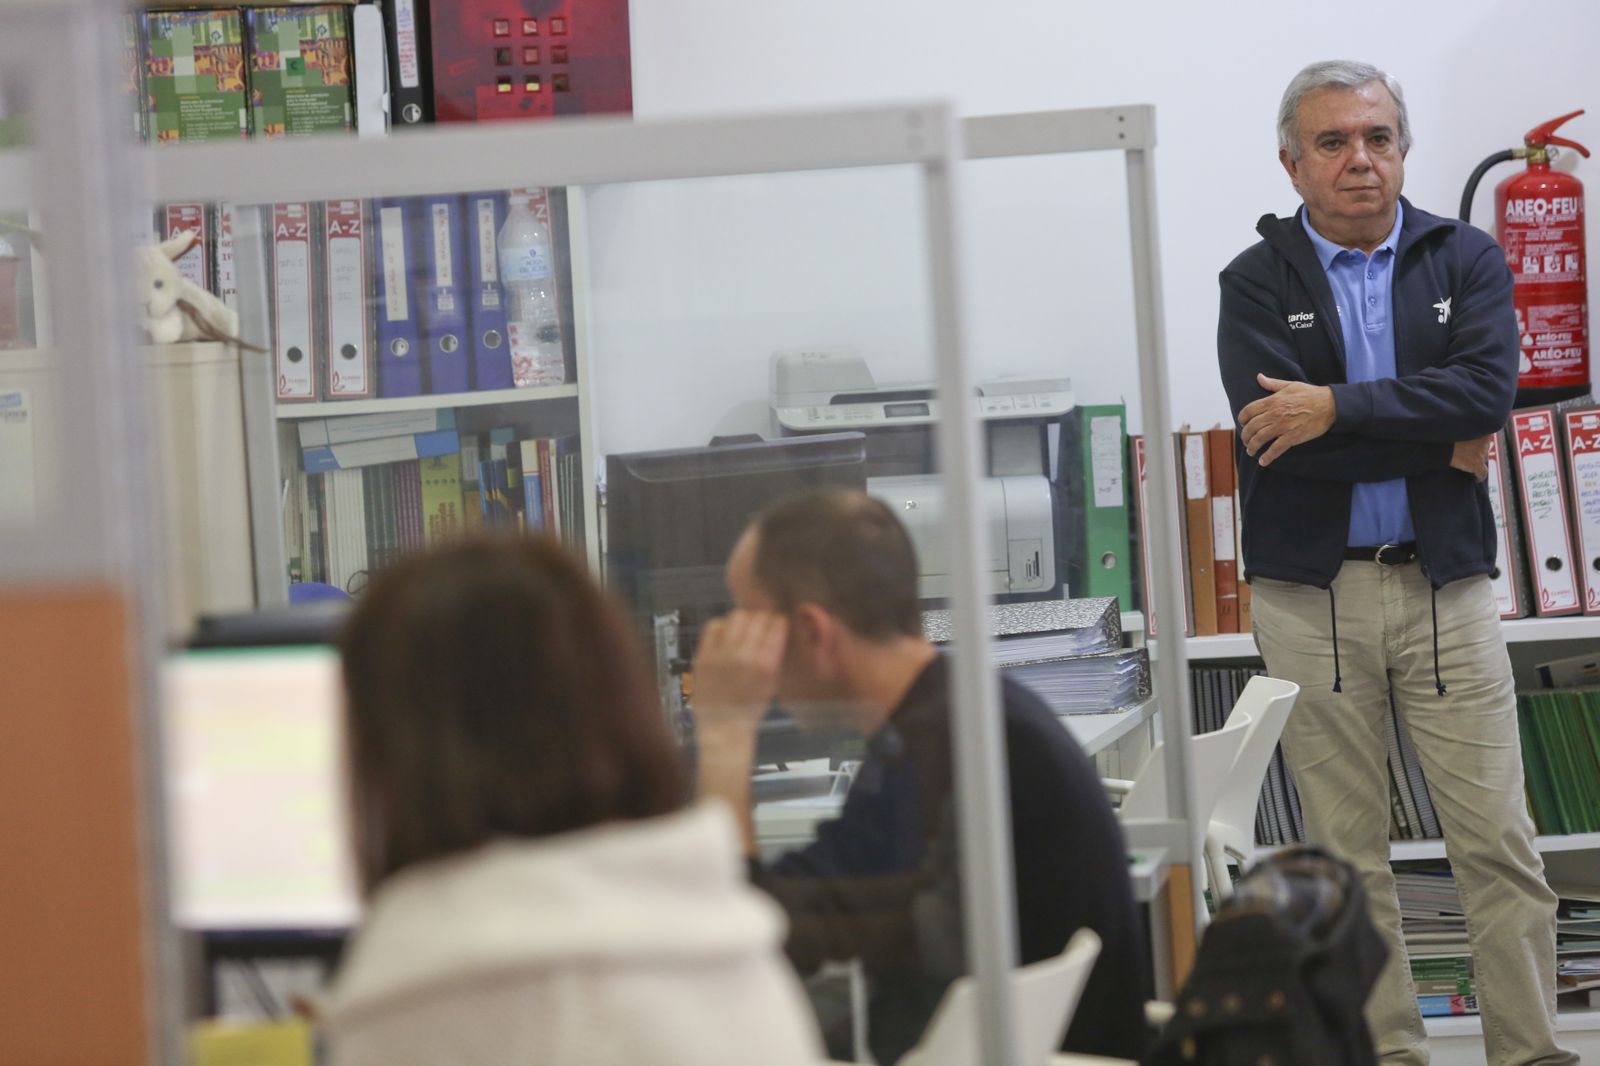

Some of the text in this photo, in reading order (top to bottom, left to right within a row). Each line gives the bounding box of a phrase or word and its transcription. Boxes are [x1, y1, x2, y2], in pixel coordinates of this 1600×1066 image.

[1506, 196, 1578, 217] AREO-FEU
[276, 222, 307, 238] A-Z
[329, 219, 361, 235] A-Z
[1521, 434, 1553, 453] A-Z
[1573, 433, 1600, 451] A-Z
